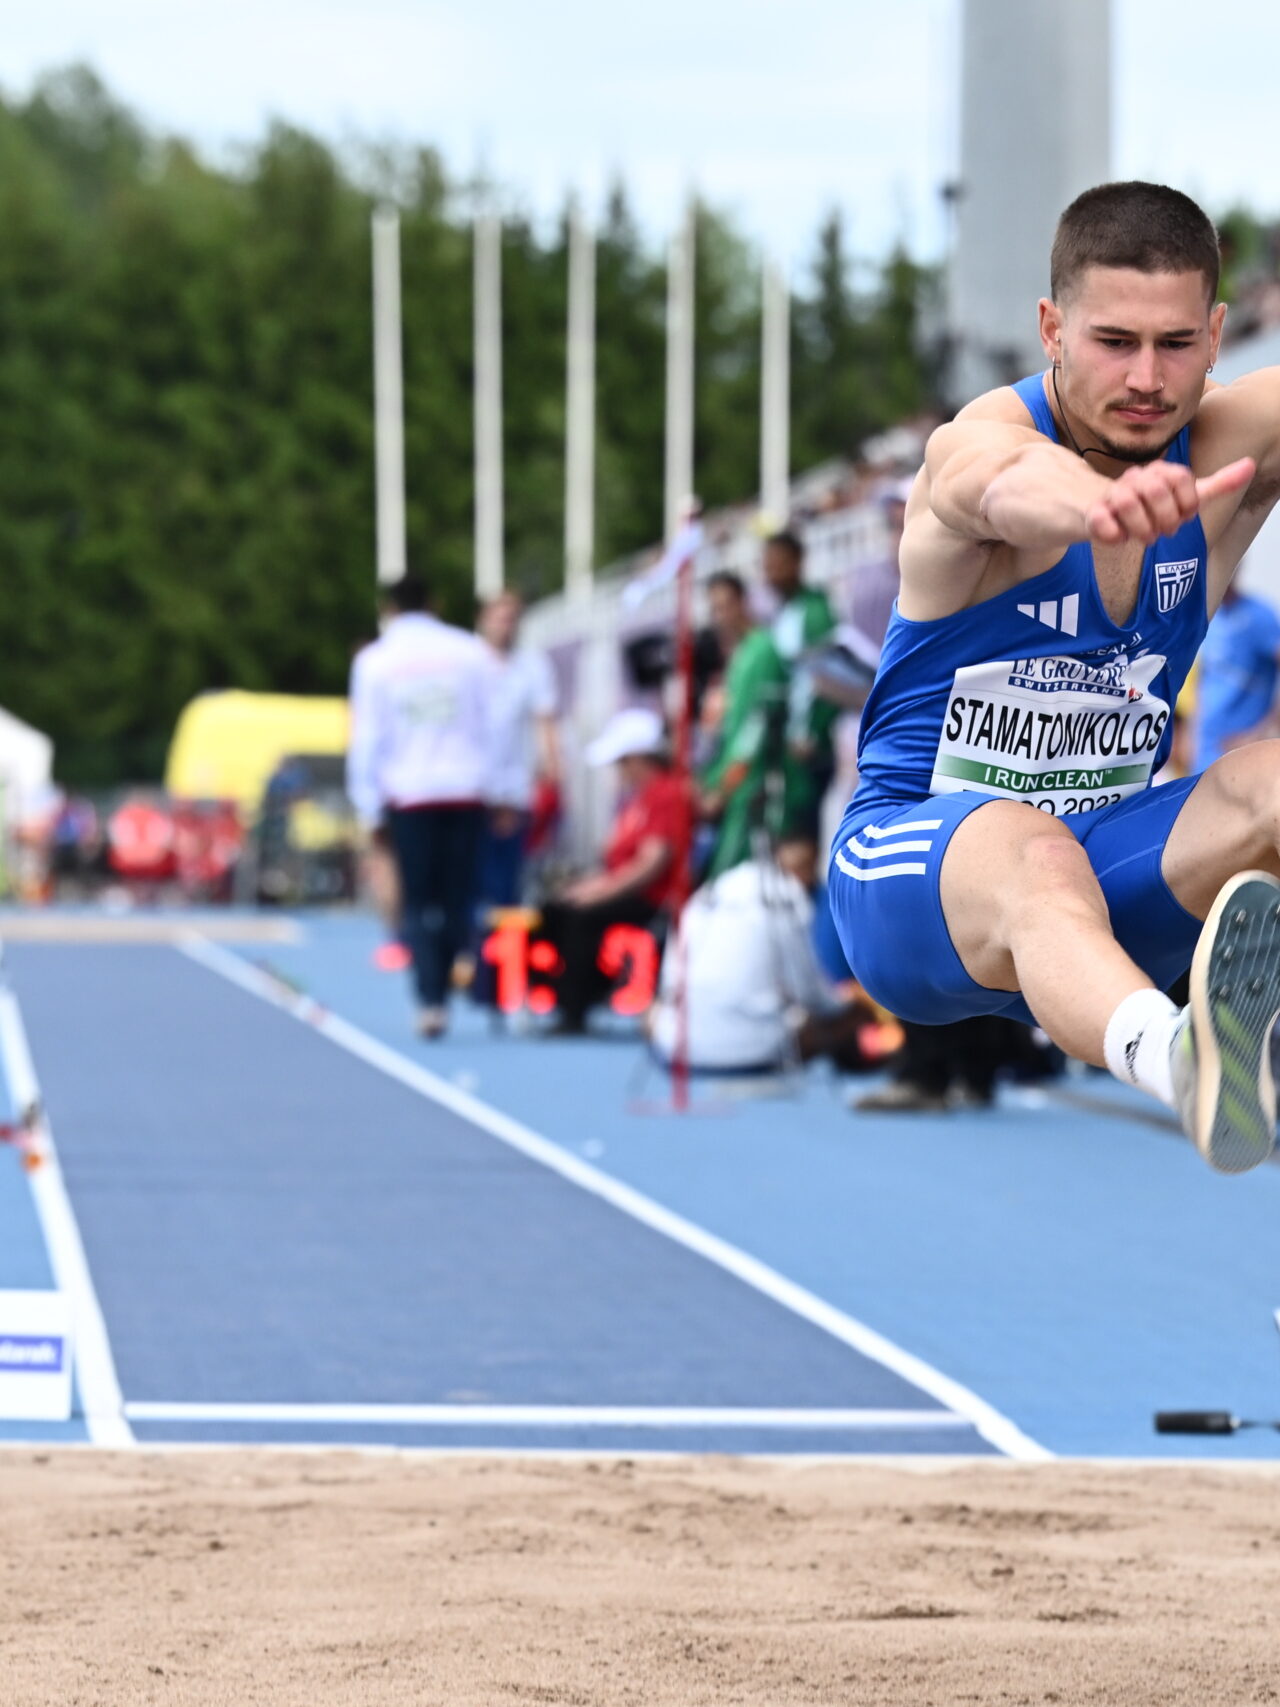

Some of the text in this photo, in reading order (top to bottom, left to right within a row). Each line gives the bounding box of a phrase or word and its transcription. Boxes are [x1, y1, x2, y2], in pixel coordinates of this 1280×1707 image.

[1012, 658, 1037, 678] LE
[1013, 678, 1121, 696] SWITZERLAND
[946, 697, 1167, 760] STAMATONIKOLOS
[984, 766, 991, 782] I
[995, 769, 1039, 791] RUN
